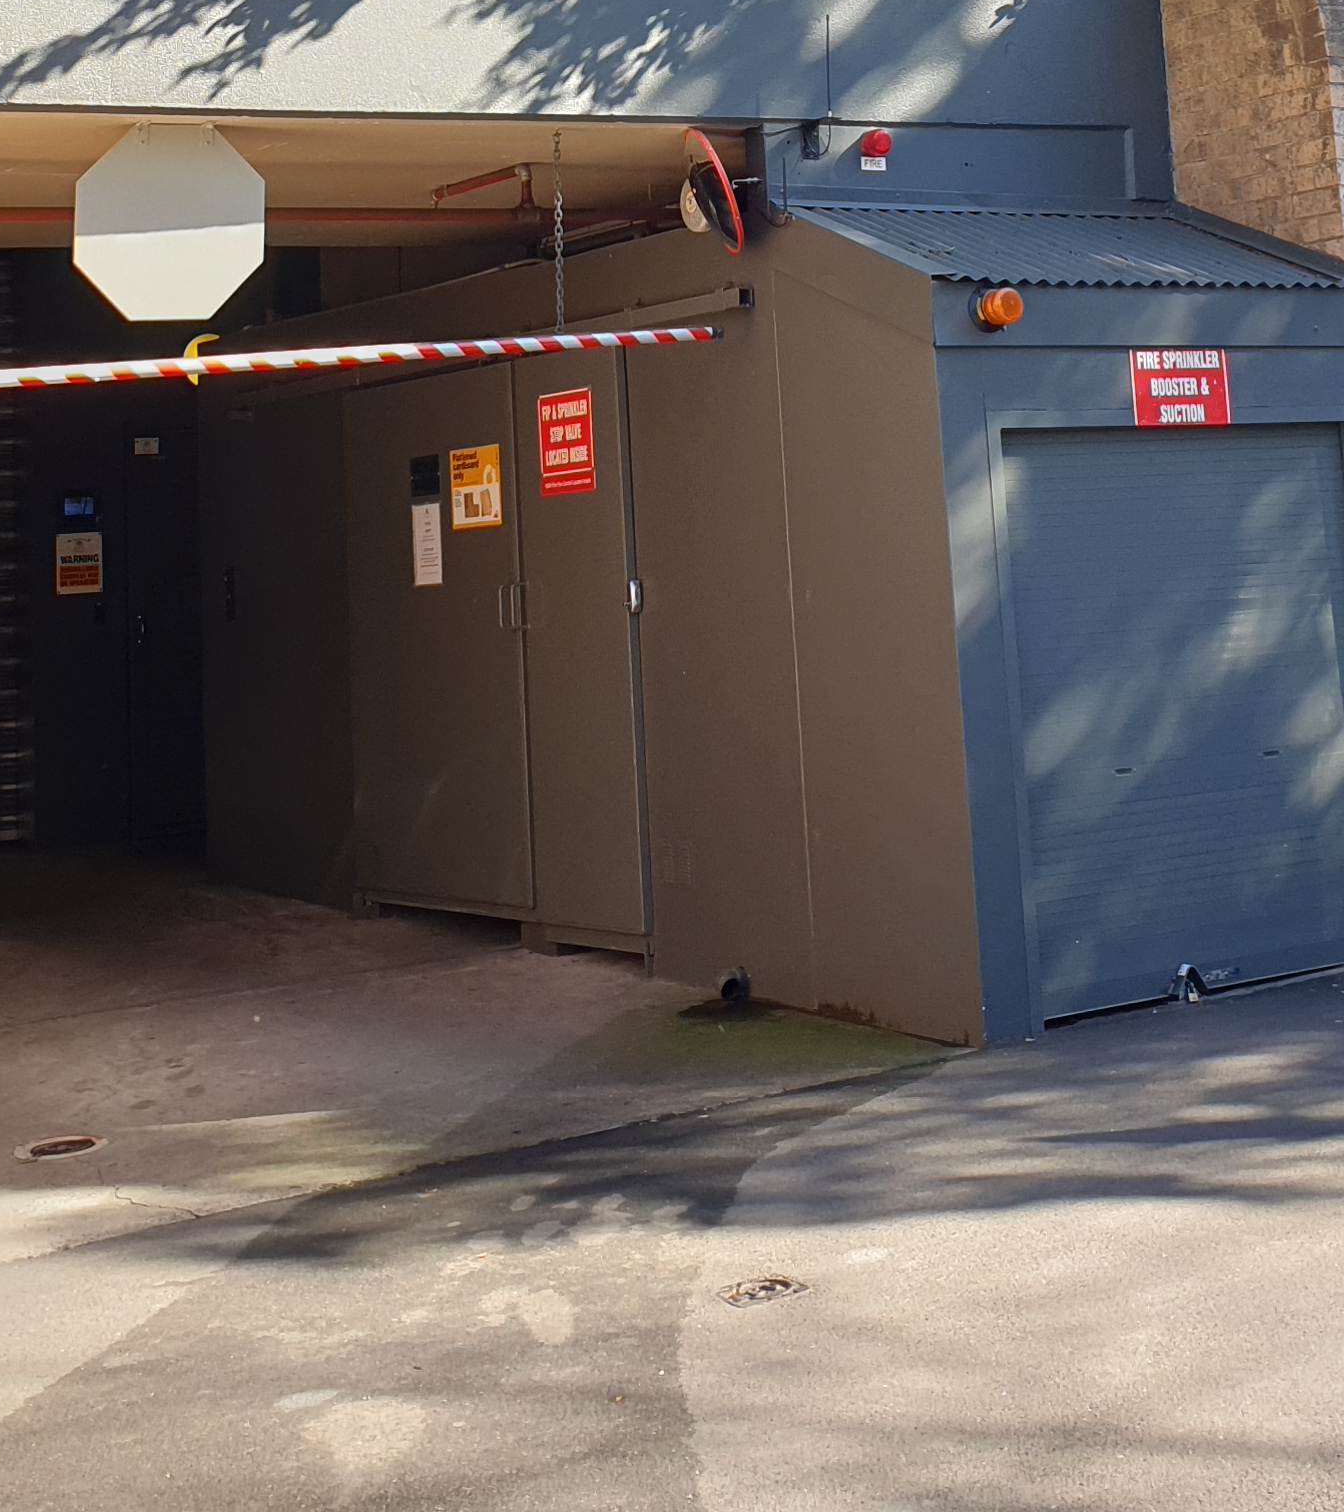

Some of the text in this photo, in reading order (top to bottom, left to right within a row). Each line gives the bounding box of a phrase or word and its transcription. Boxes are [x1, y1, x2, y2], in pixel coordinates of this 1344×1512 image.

[864, 159, 883, 168] FIRE
[1136, 350, 1220, 370] FIRE SPRINKLER
[1150, 376, 1210, 396] BOOSTER &
[1160, 403, 1205, 423] SUCTION
[60, 553, 100, 564] WARNING
